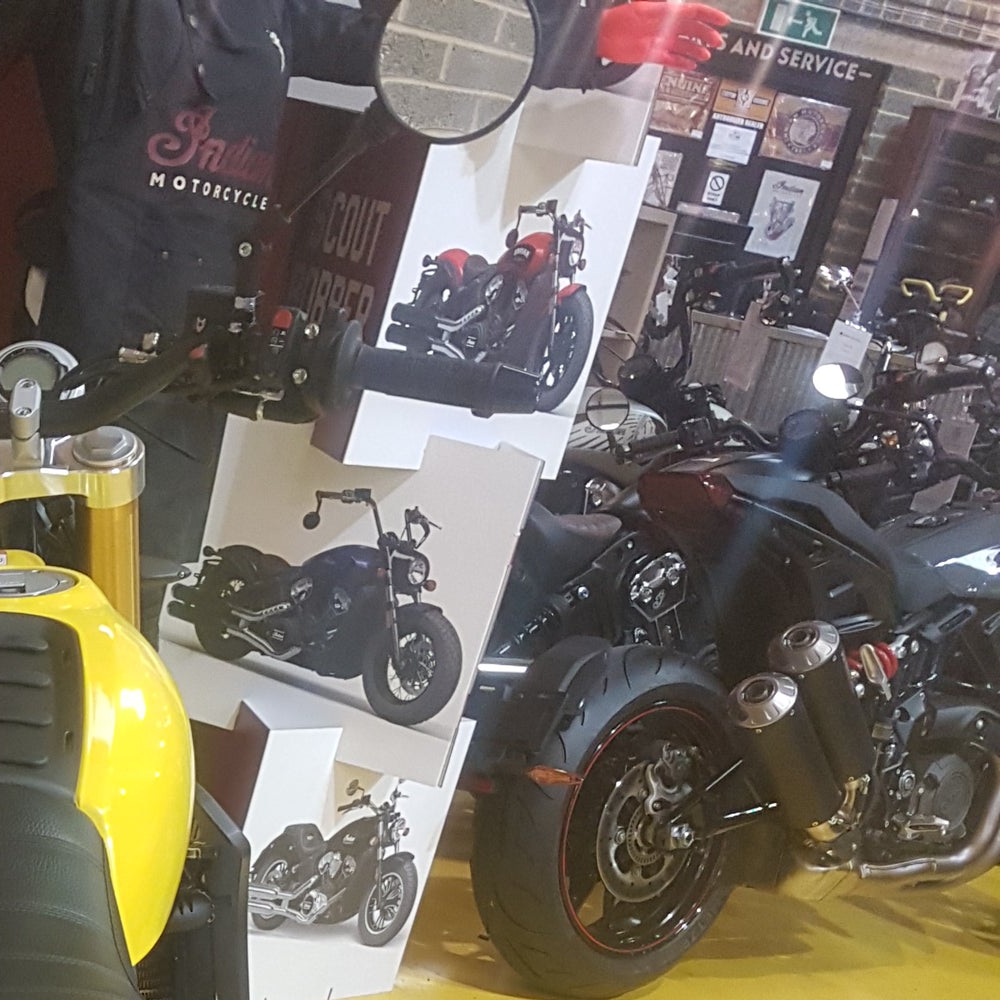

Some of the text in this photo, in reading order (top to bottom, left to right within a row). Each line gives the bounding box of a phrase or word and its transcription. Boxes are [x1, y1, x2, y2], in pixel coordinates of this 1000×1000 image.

[731, 38, 774, 61] AND
[149, 172, 268, 211] MOTORCYCLE
[322, 190, 393, 267] COUT
